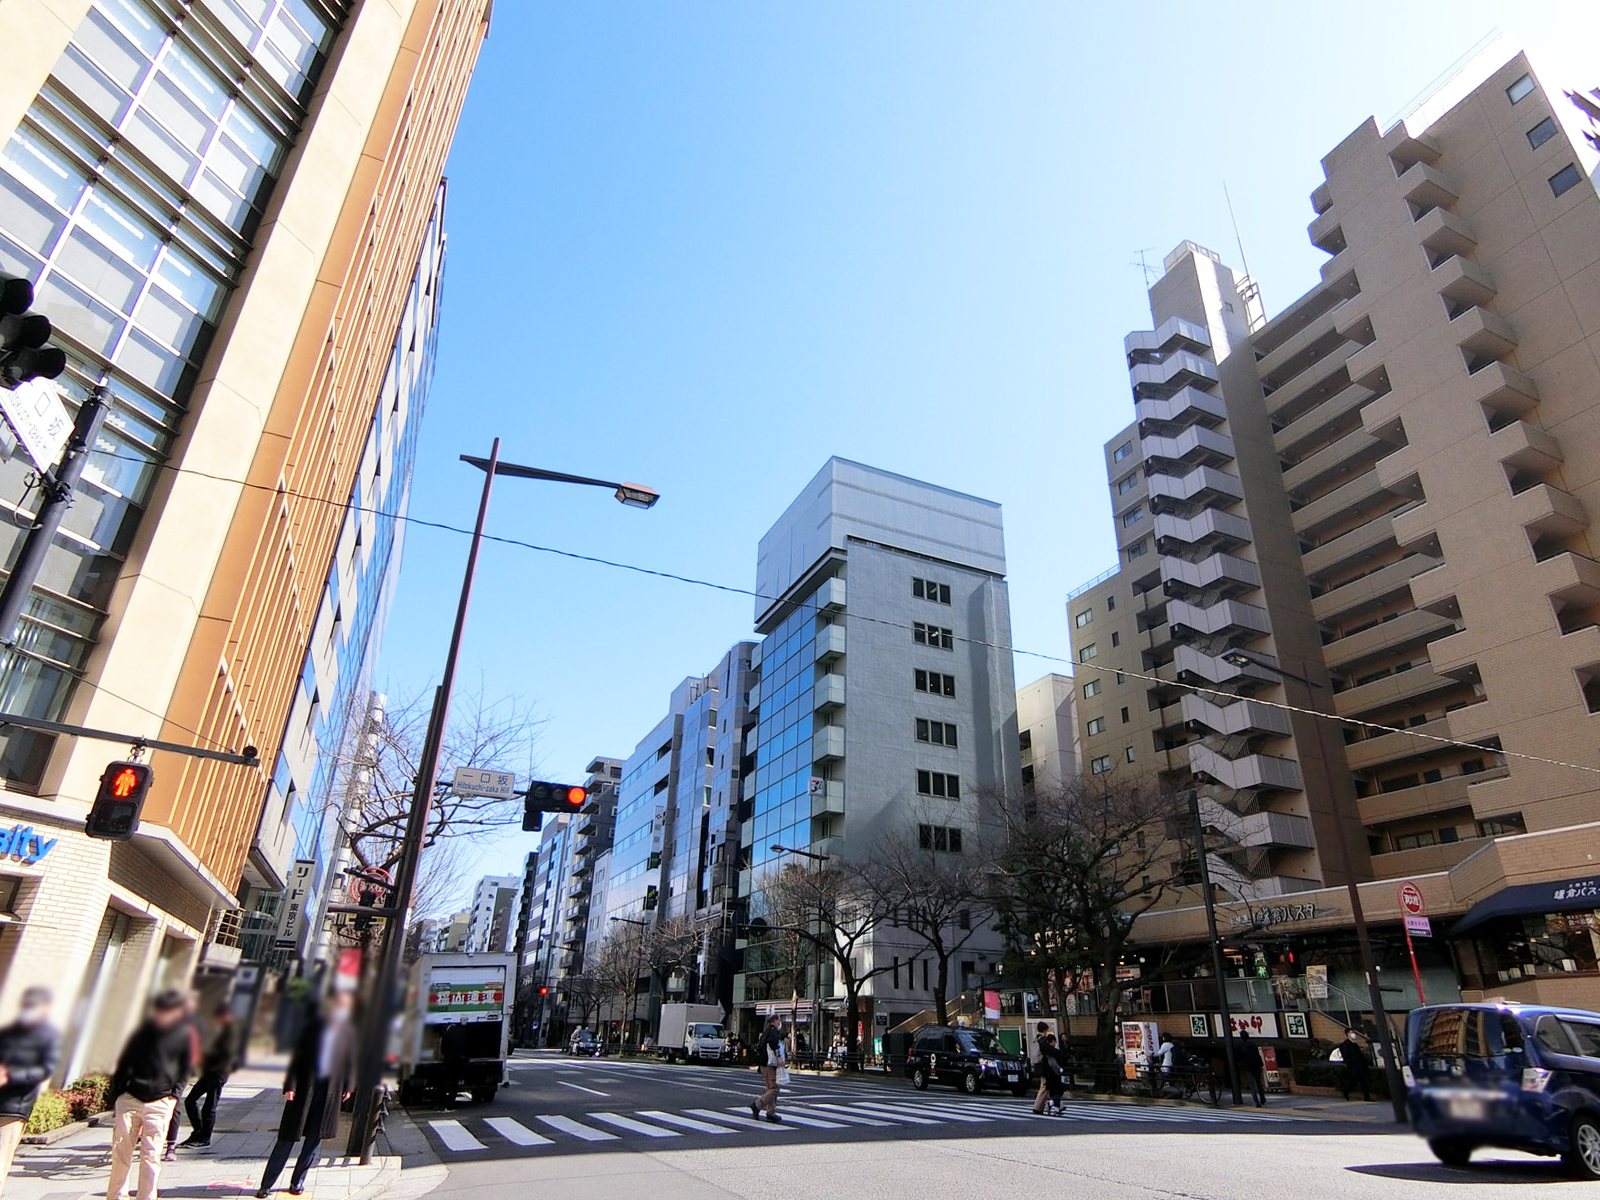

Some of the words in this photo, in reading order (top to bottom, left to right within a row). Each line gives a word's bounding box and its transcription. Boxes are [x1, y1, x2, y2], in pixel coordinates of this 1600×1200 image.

[31, 383, 65, 442] 口坂
[462, 773, 508, 786] 一口坂
[457, 781, 499, 793] Hitokuchi-zaka
[1553, 886, 1600, 900] 鎌倉パス
